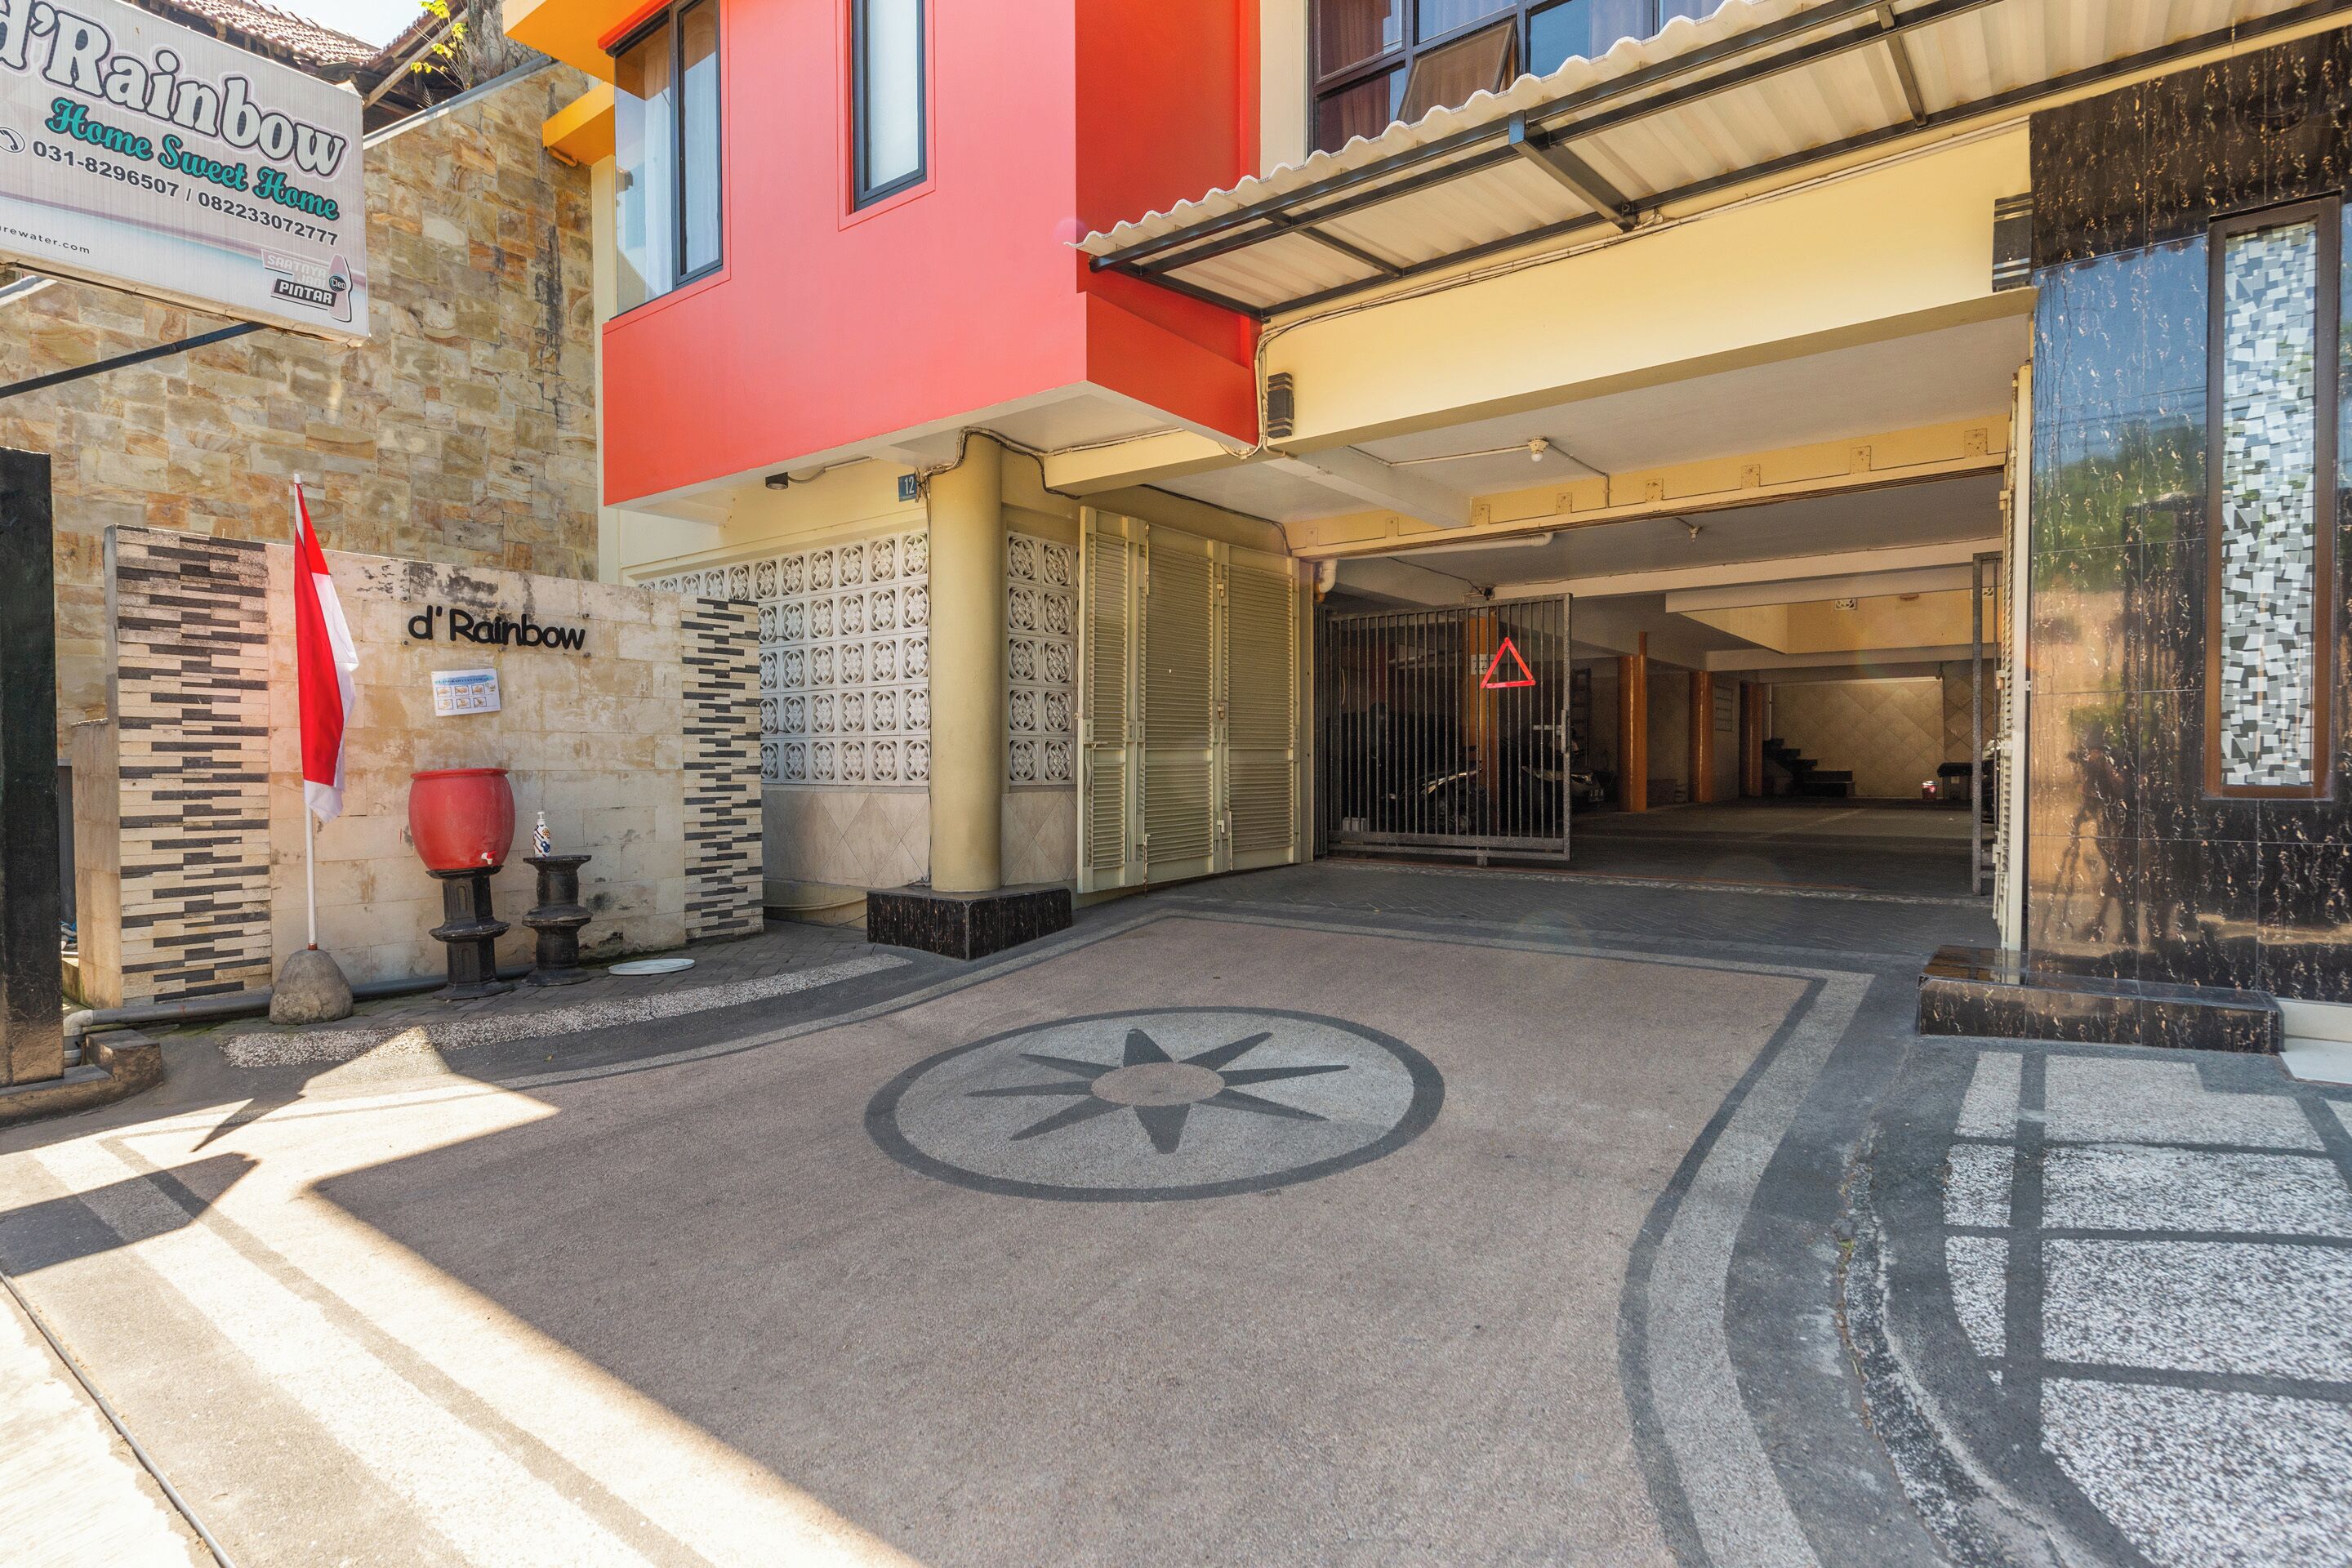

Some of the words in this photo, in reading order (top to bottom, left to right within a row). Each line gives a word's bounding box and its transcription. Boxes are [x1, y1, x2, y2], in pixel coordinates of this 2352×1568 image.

[45, 96, 154, 160] Home
[160, 134, 249, 192] Sweet
[252, 167, 340, 221] Home
[33, 140, 180, 197] 031-8296507
[198, 192, 338, 246] 082233072777
[0, 225, 91, 254] rewater.com
[267, 254, 327, 278] SAATNYA
[278, 281, 332, 305] PINTAR
[332, 278, 346, 290] Cleo
[905, 476, 915, 494] 12
